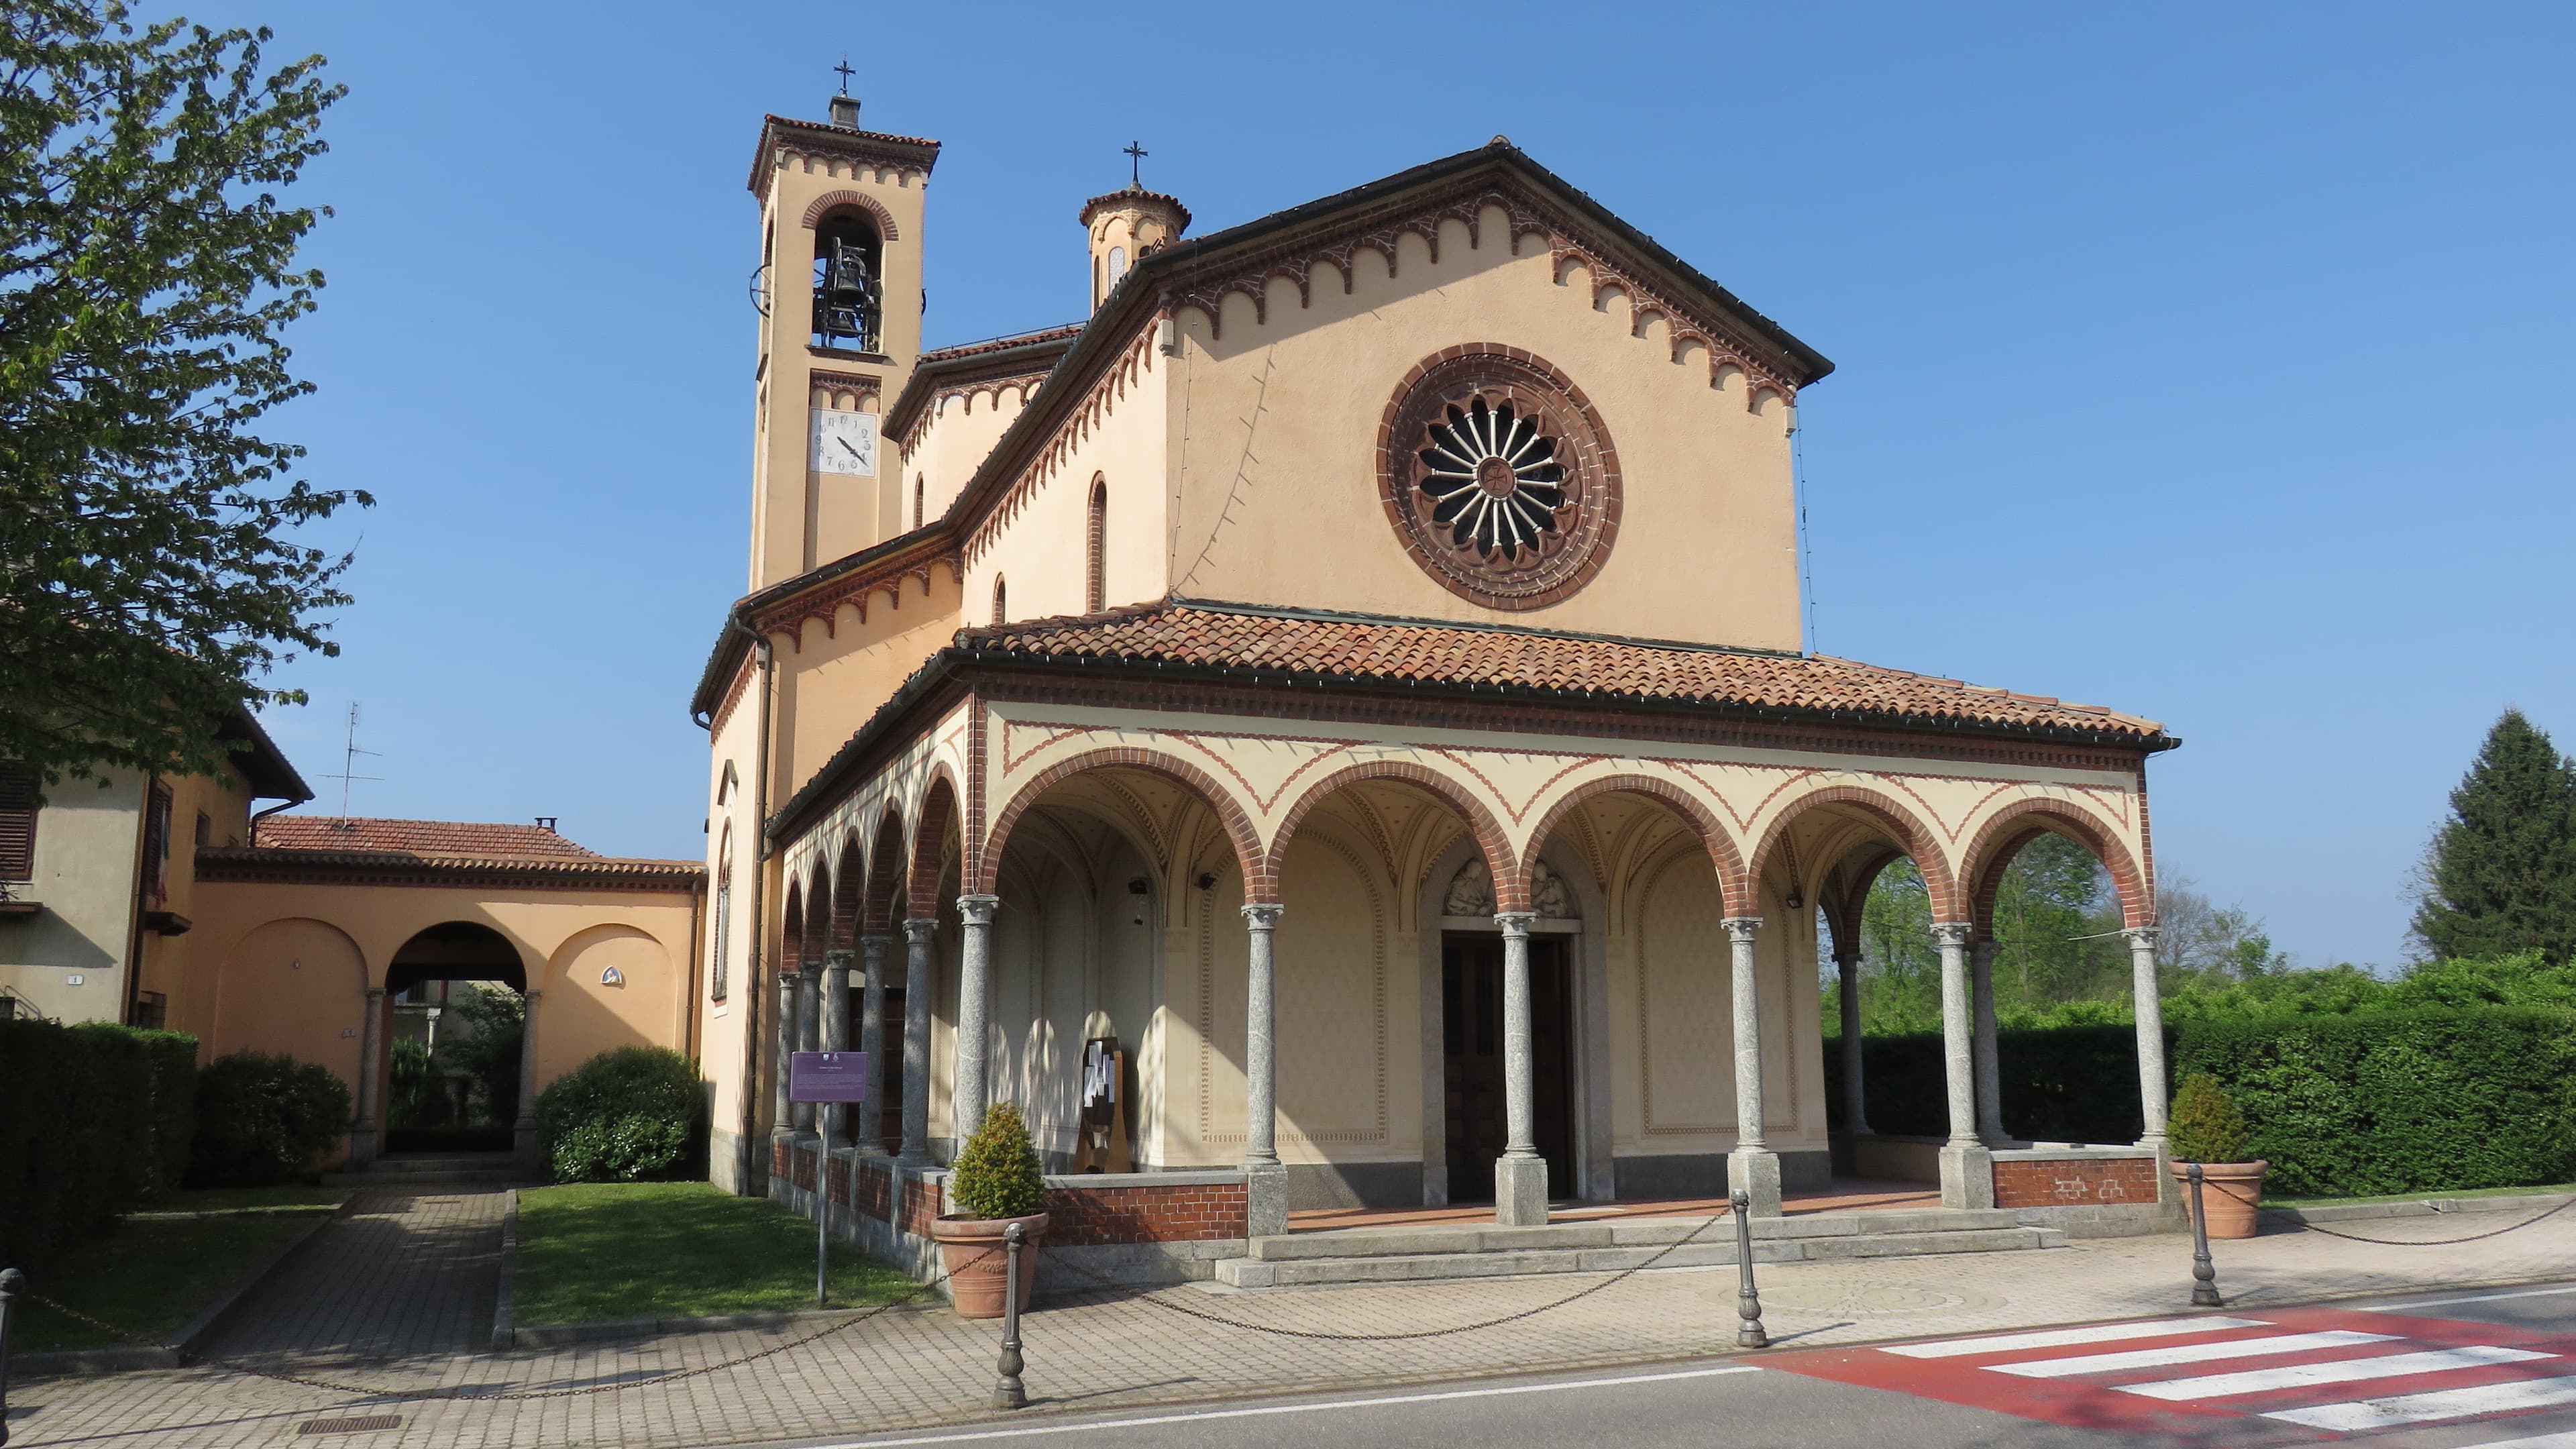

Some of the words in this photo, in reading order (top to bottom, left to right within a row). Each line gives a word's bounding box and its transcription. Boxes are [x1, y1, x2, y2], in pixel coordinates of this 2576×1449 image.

[828, 417, 835, 427] 11
[839, 415, 848, 424] 12
[854, 420, 857, 429] 1
[861, 429, 868, 438] 2
[816, 435, 821, 444] 9
[827, 456, 833, 466] 7
[838, 460, 845, 471] 6
[851, 460, 857, 469] 5
